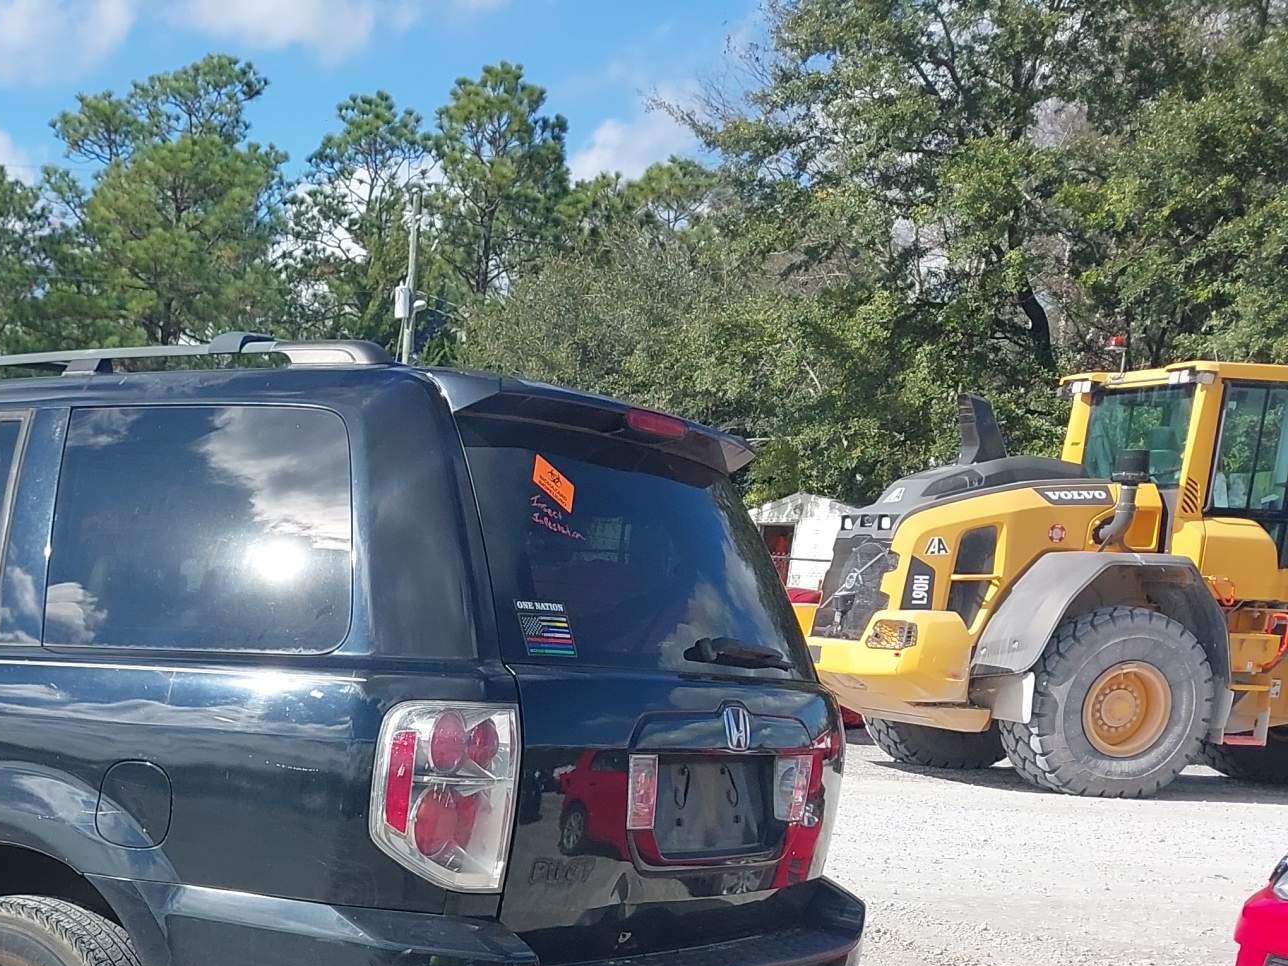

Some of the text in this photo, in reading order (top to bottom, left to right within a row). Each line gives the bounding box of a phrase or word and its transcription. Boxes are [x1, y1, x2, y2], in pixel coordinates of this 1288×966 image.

[1044, 490, 1107, 500] VOLVO
[530, 494, 562, 520] Insect
[912, 575, 930, 605] L90H
[516, 601, 564, 612] ONE NATION
